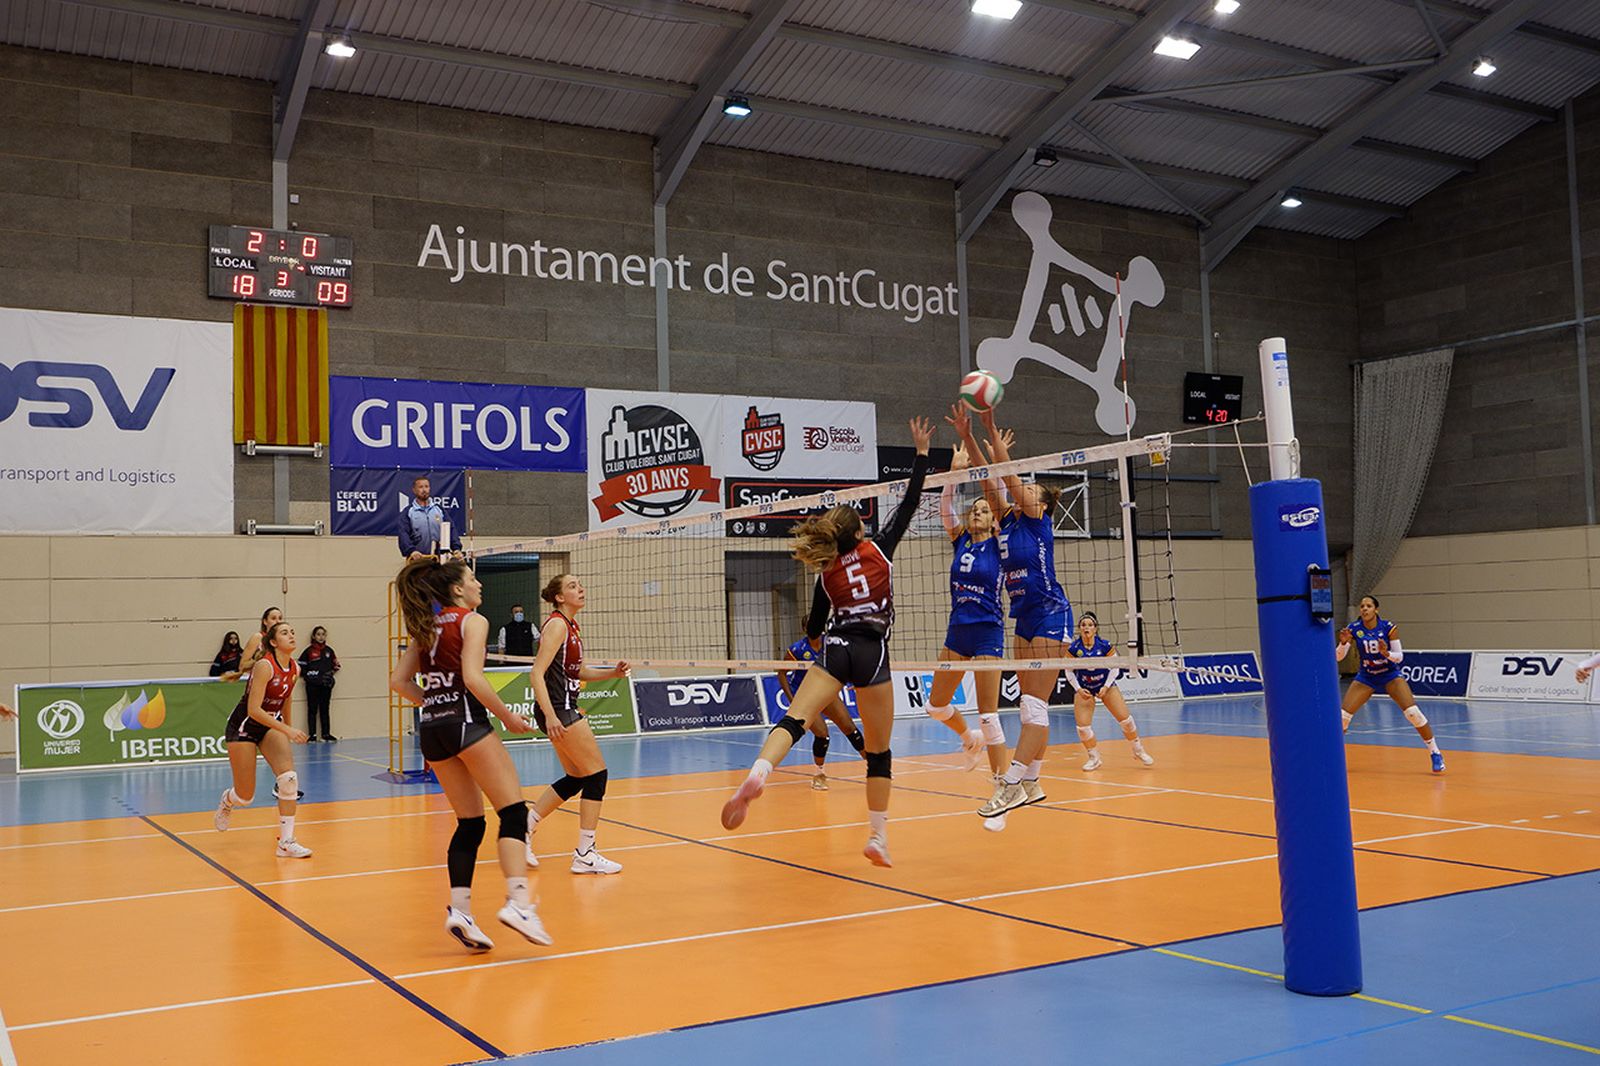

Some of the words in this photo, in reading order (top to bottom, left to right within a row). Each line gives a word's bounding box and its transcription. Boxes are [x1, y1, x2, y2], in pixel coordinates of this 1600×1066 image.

[247, 231, 263, 253] 2
[302, 237, 317, 257] 0
[215, 256, 255, 269] LOCAL
[310, 265, 347, 277] VISITANT
[277, 271, 289, 286] 3
[417, 224, 692, 291] Ajuntament
[703, 252, 755, 297] de
[766, 260, 959, 323] SantCugat
[233, 274, 255, 295] 18
[269, 288, 296, 298] PERIODE
[318, 282, 348, 303] 09
[351, 398, 570, 453] GRIFOLS
[829, 426, 855, 436] Escola
[637, 423, 690, 456] CVSC
[744, 428, 782, 452] CVSC
[605, 461, 625, 473] CLUB
[626, 457, 657, 469] VOLEIBOL
[658, 453, 676, 464] SANT
[1061, 451, 1086, 465] FIVB
[0, 468, 70, 483] ransport
[75, 468, 104, 482] and
[109, 468, 176, 487] Logistics
[626, 472, 649, 496] 30
[651, 467, 690, 490] ANYS
[967, 467, 989, 480] FIVB
[336, 490, 378, 499] L'EFECTE
[336, 500, 378, 512] BLAU
[960, 552, 976, 573] 9
[846, 563, 871, 600] 5
[1362, 640, 1380, 654] 18
[1186, 664, 1252, 685] GRIFOLS
[1401, 666, 1458, 684] SOREA
[1502, 657, 1563, 676] DSV
[667, 683, 729, 706] DSV
[1479, 686, 1499, 694] Global
[1501, 687, 1533, 696] Transport
[1534, 687, 1546, 695] and
[1548, 686, 1580, 697] Logistics
[649, 716, 673, 727] Global
[674, 715, 708, 726] Transport
[710, 714, 722, 723] and
[724, 712, 755, 724] Logistics
[44, 746, 81, 756] MUJER
[121, 736, 227, 758] IBERDR
